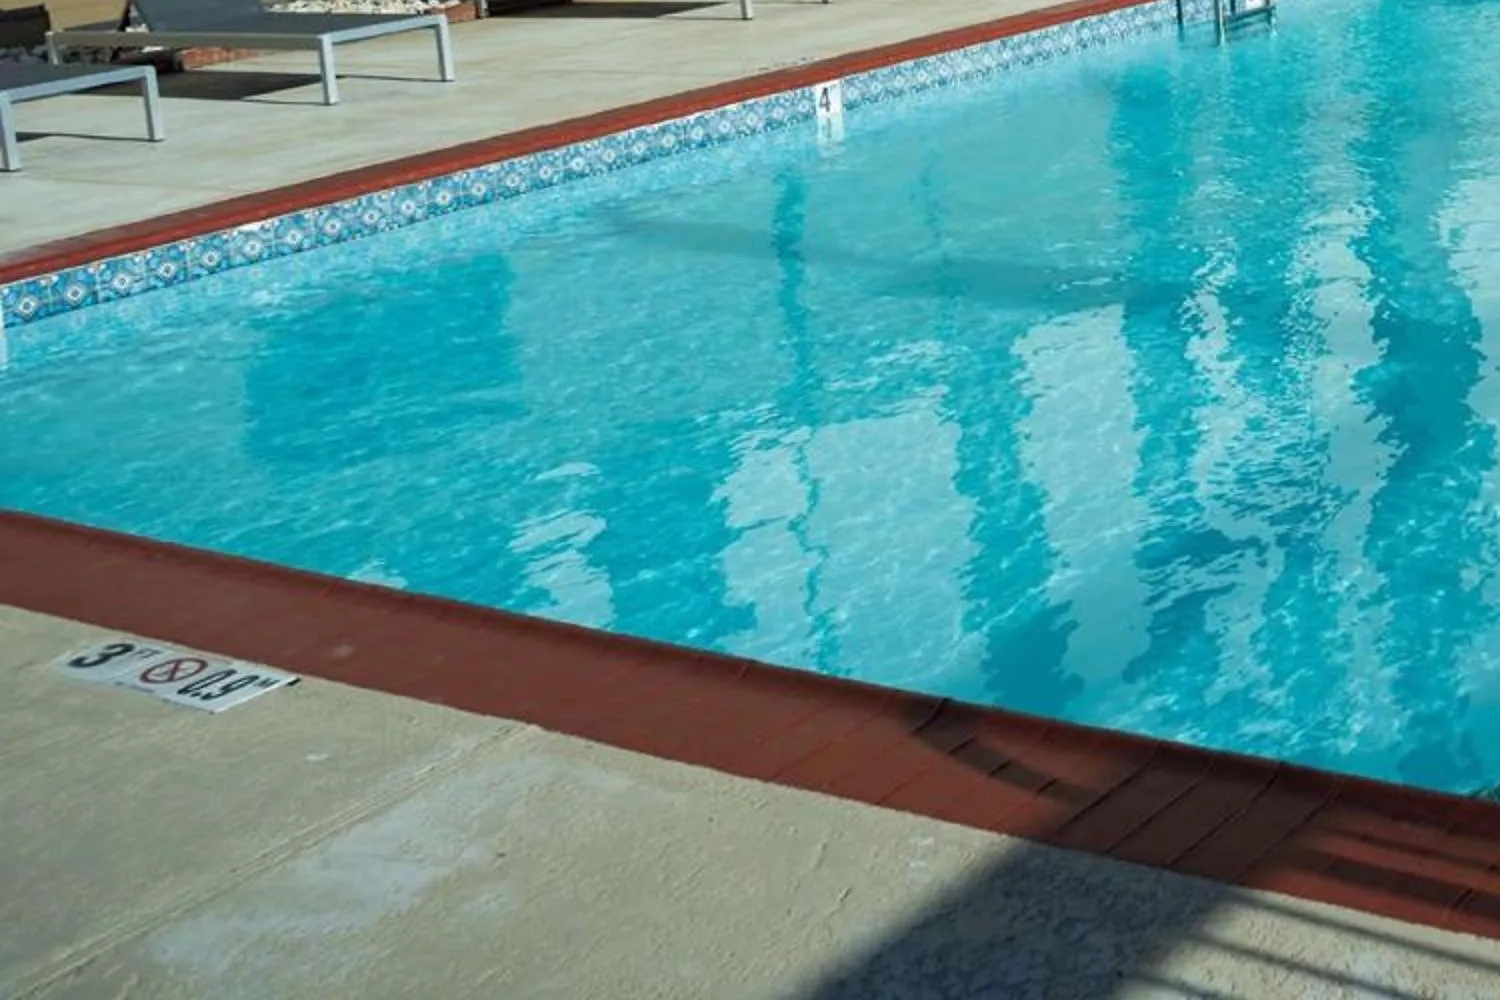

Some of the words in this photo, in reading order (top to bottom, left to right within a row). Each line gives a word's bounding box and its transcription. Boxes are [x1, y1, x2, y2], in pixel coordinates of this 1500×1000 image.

[819, 87, 831, 113] 4
[67, 643, 136, 668] 3
[176, 668, 260, 701] 0.9
